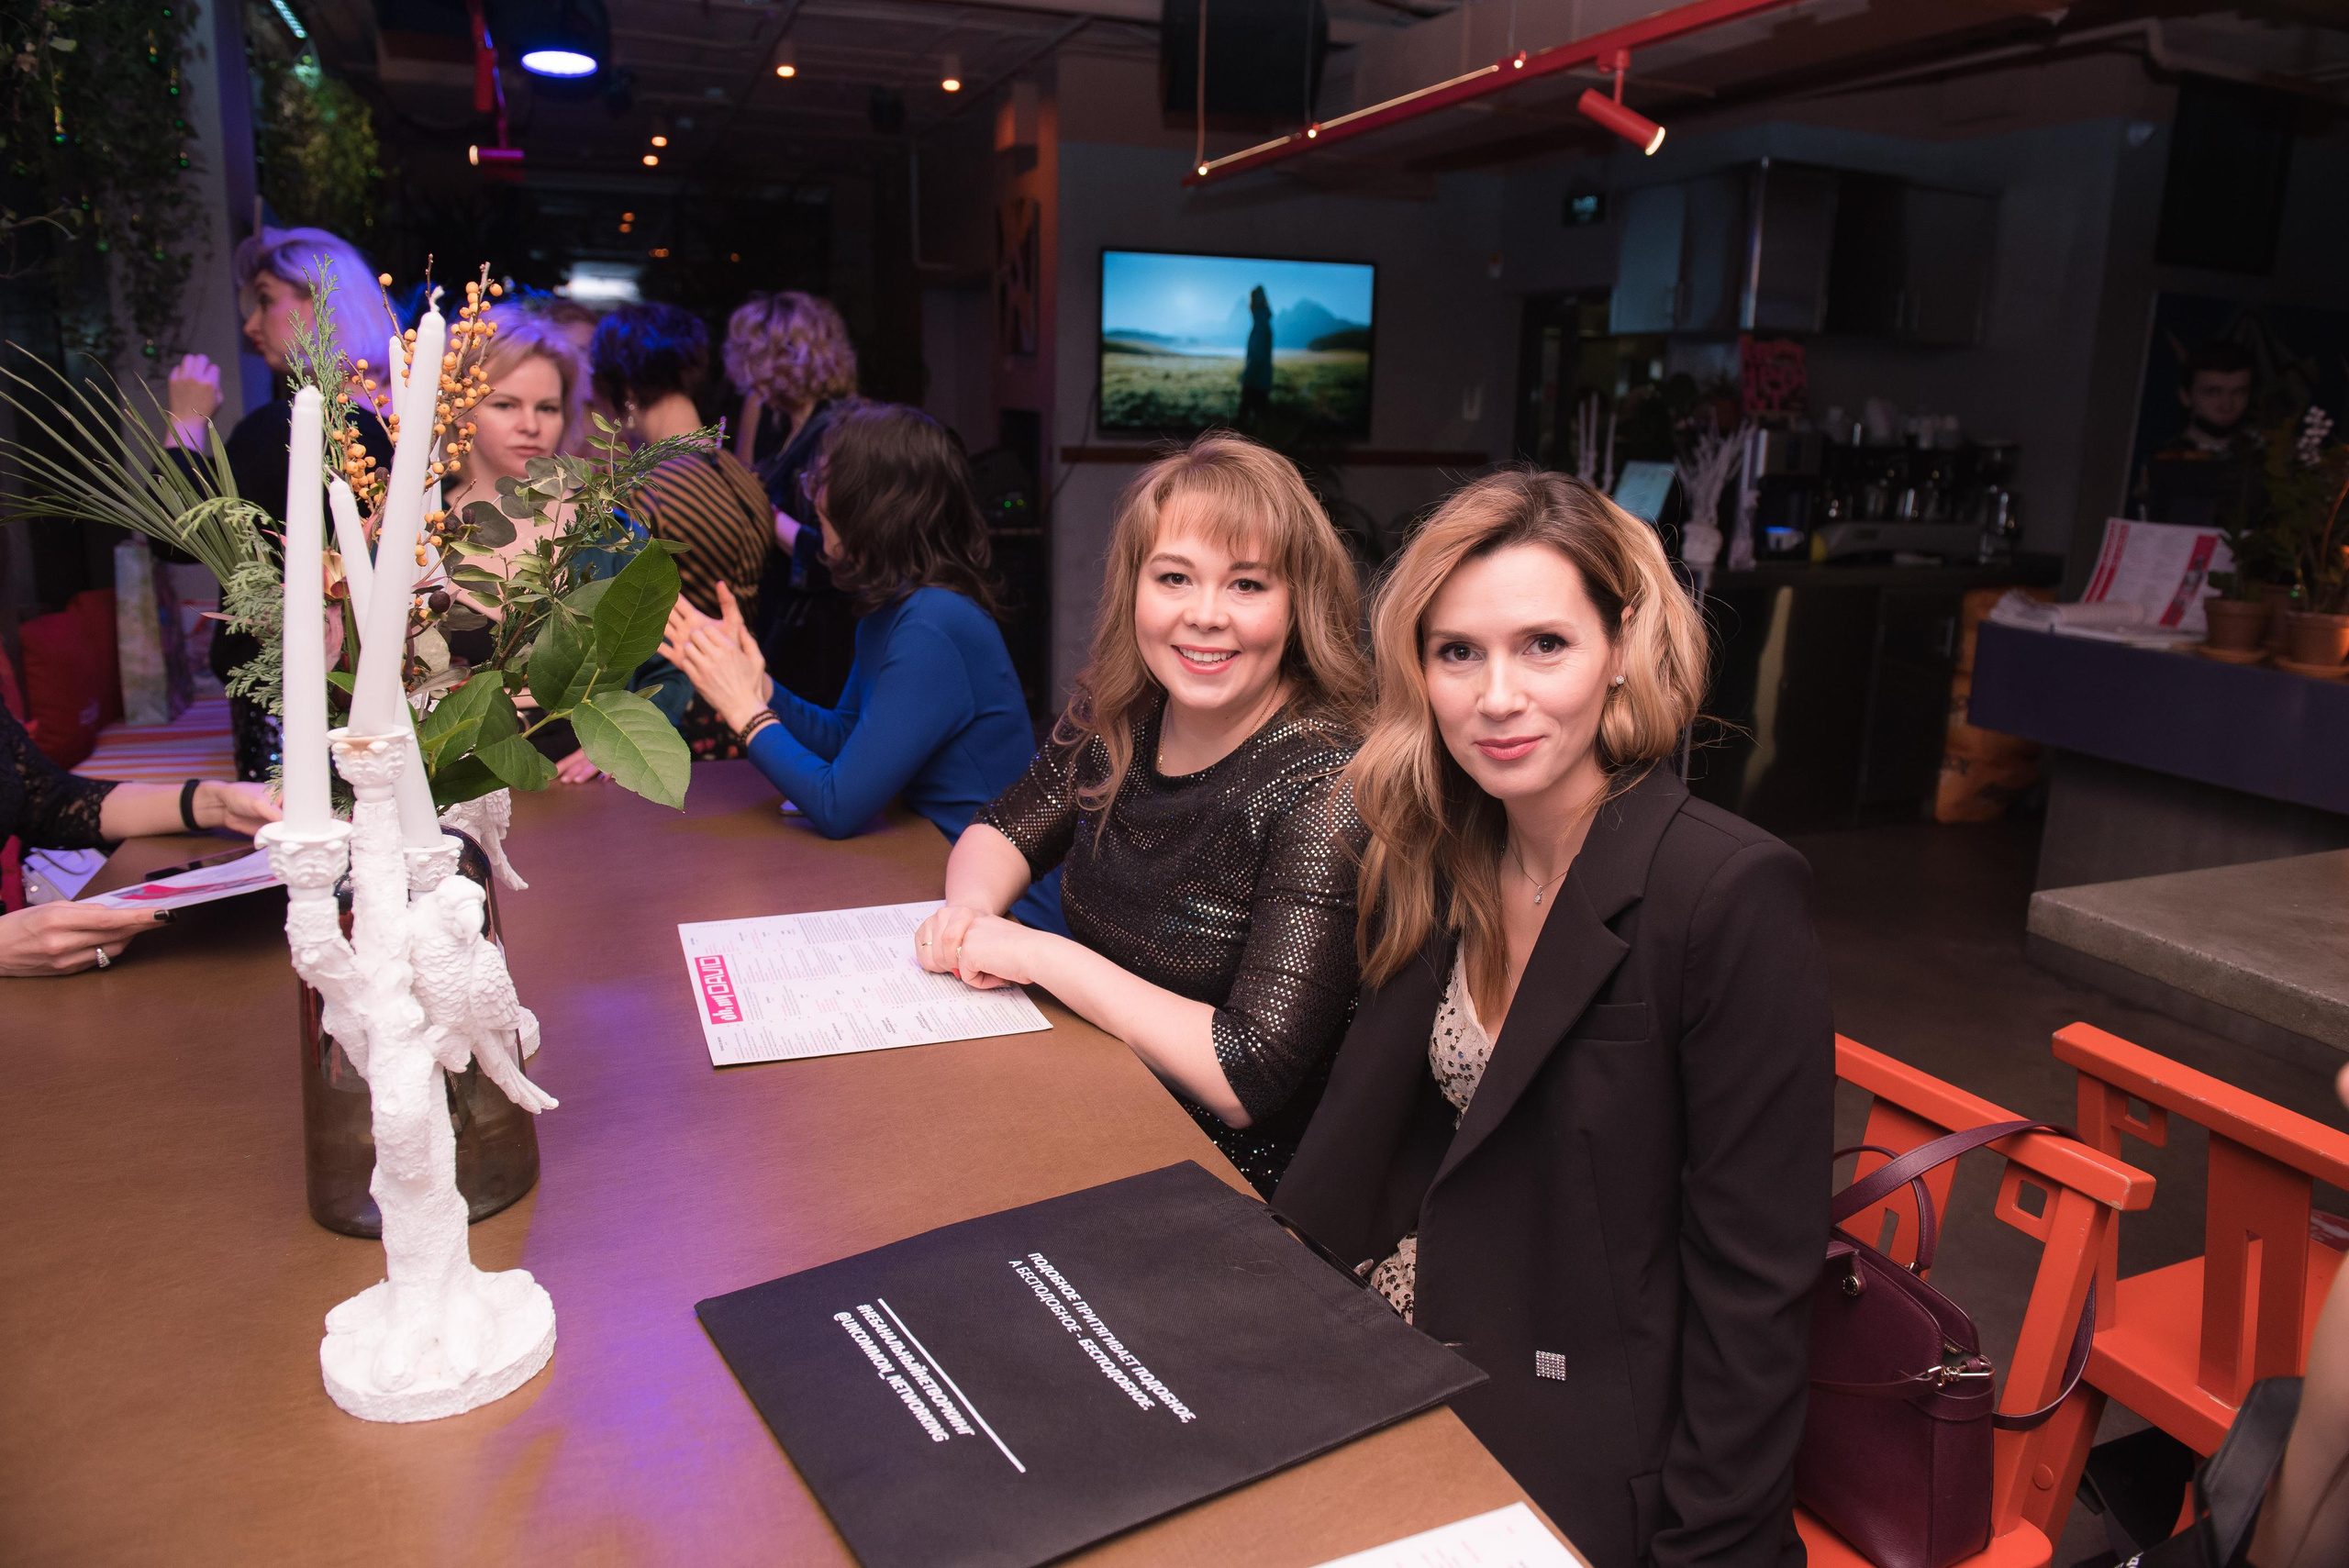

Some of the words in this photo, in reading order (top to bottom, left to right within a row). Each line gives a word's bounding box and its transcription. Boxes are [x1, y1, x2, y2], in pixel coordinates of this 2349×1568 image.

[699, 956, 730, 995] DAVID
[711, 995, 734, 1006] my
[833, 1311, 950, 1443] @UNCOMMON_NETWORKING
[856, 1304, 975, 1436] #НЕБАНАЛЬНЫЙНЕТВОРКИНГ
[1008, 1260, 1023, 1268] А
[1016, 1266, 1082, 1333] БЕСПОДОБНОЕ
[1078, 1338, 1156, 1411] БЕСПОДОБНОЕ.
[1028, 1252, 1081, 1302] ПОДОБНОЕ
[1072, 1301, 1141, 1366] ПРИТЯГИВАЕТ
[1131, 1366, 1197, 1423] ПОДОБНОЕ,
